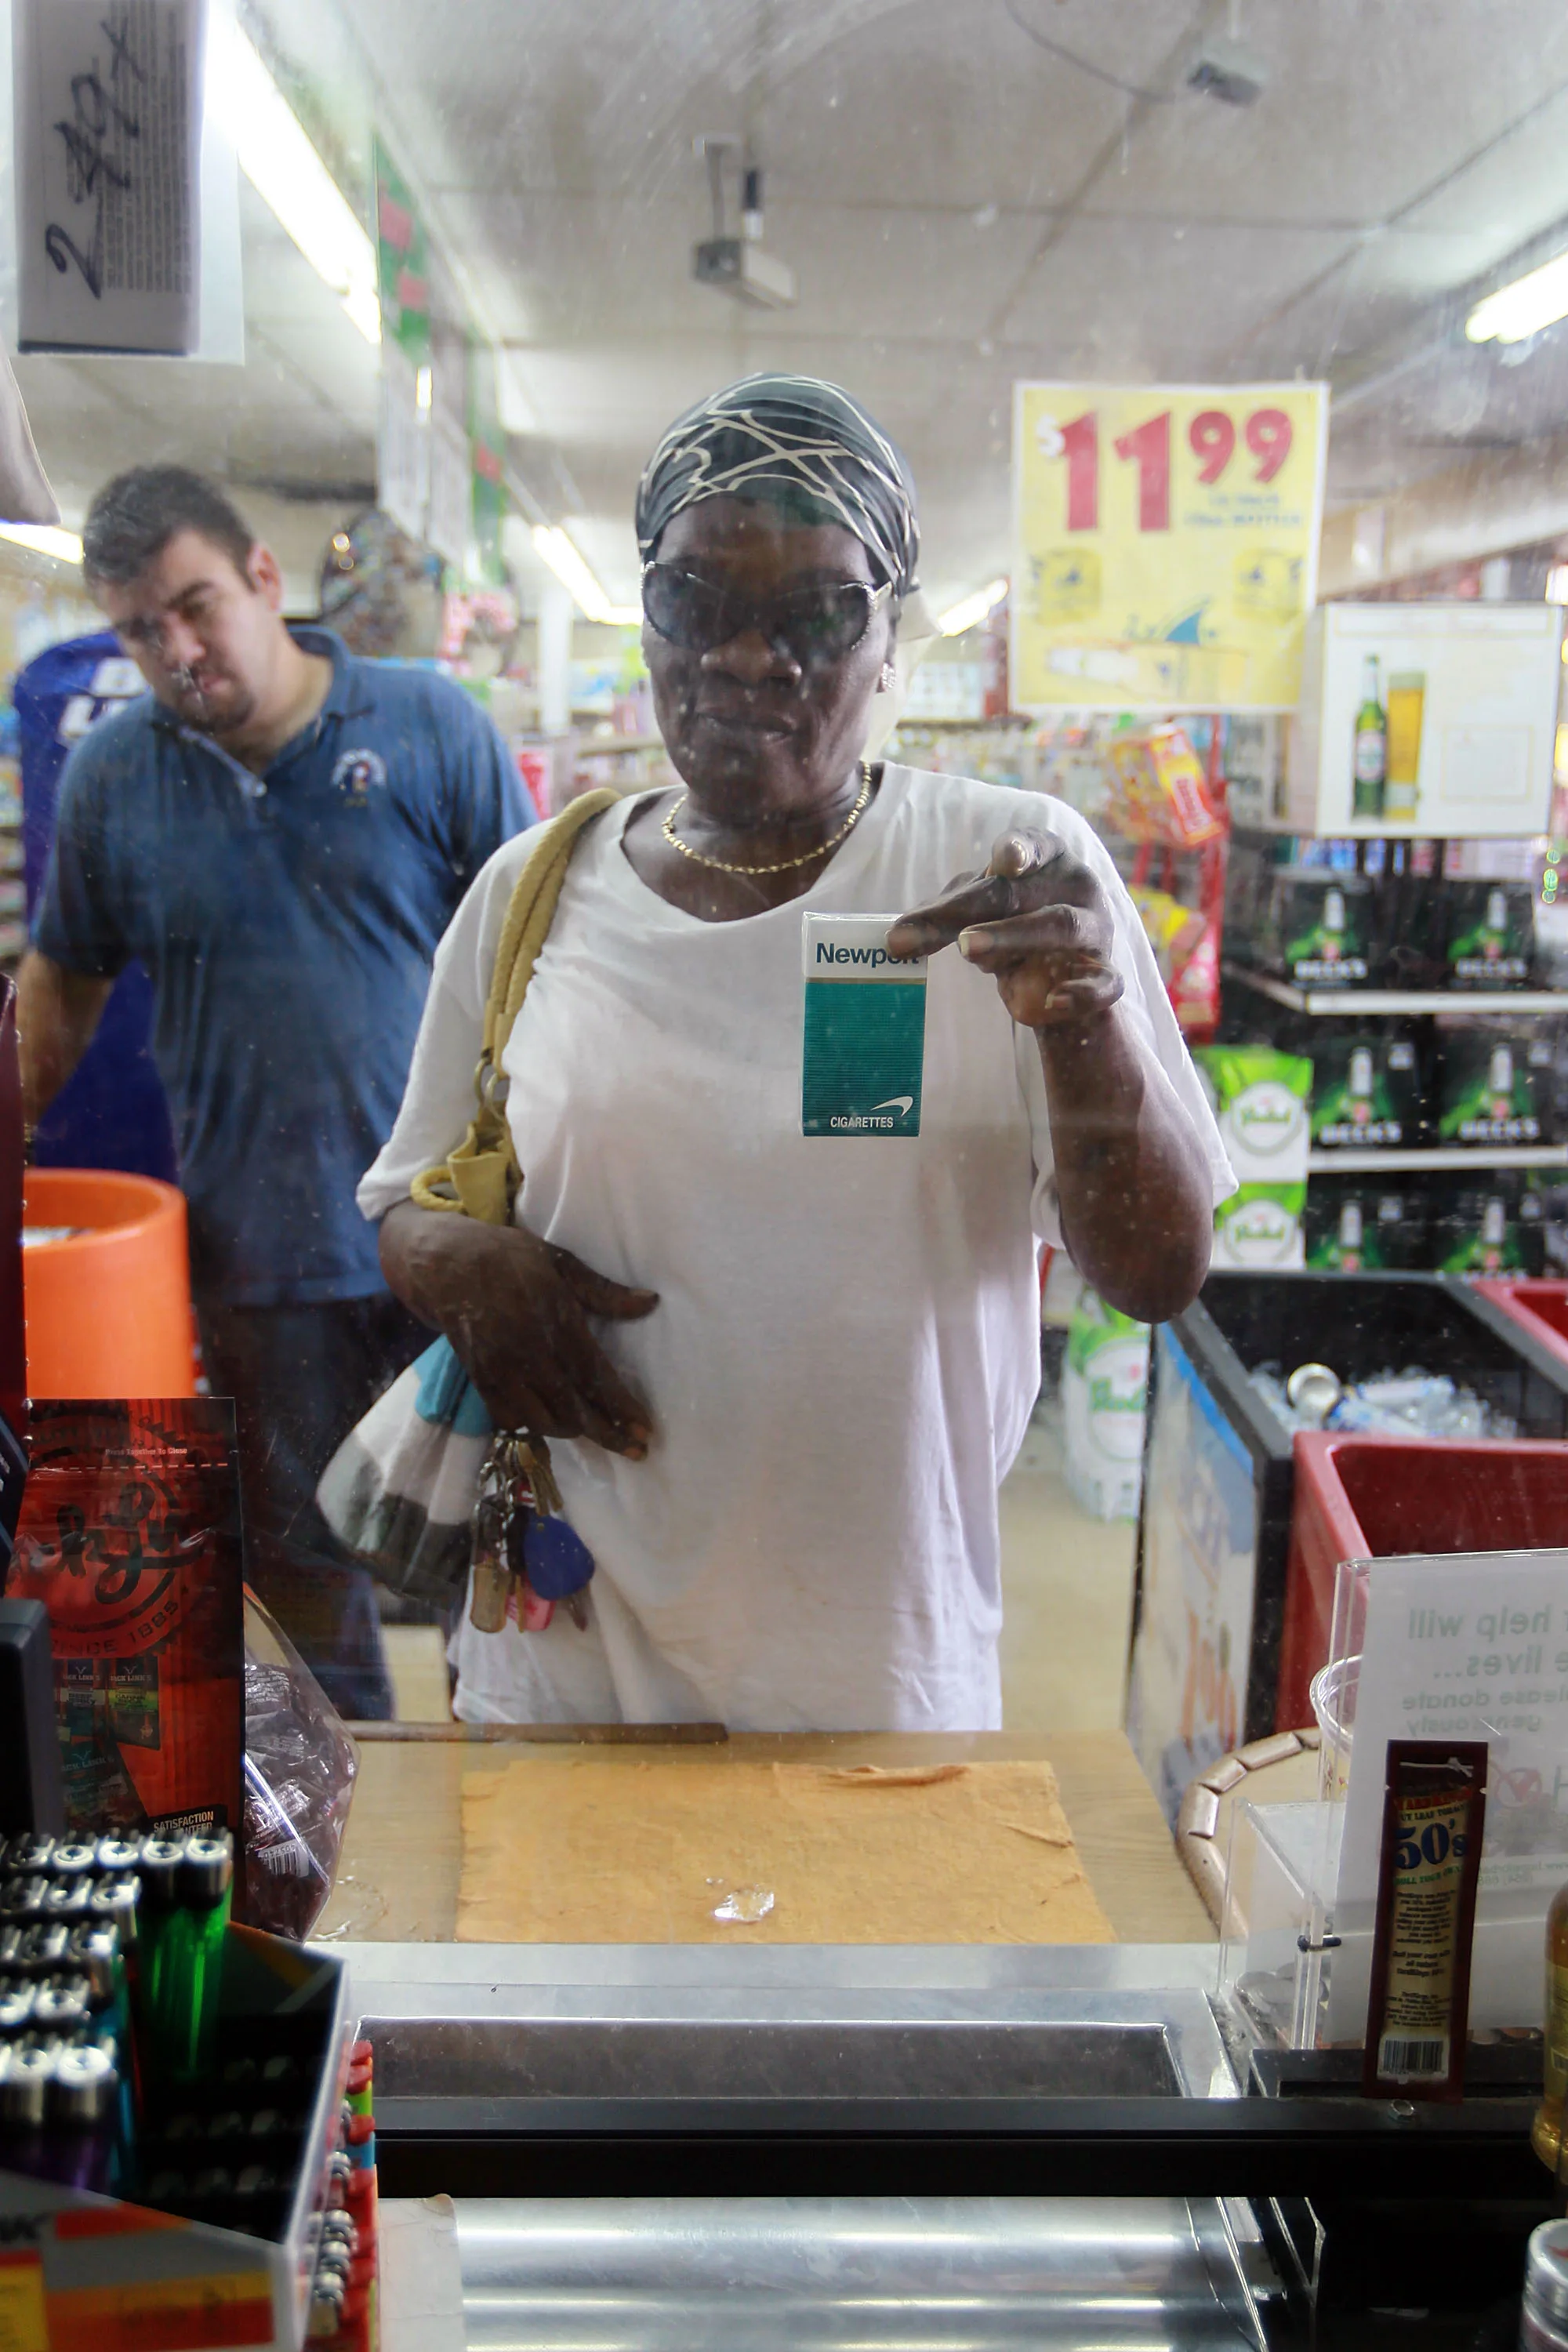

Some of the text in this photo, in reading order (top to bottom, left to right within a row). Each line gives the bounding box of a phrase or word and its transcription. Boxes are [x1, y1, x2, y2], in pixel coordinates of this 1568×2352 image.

[816, 942, 920, 968] Newp
[830, 1116, 894, 1128] CIGARETTES
[154, 1811, 213, 1832] SATISFACTION
